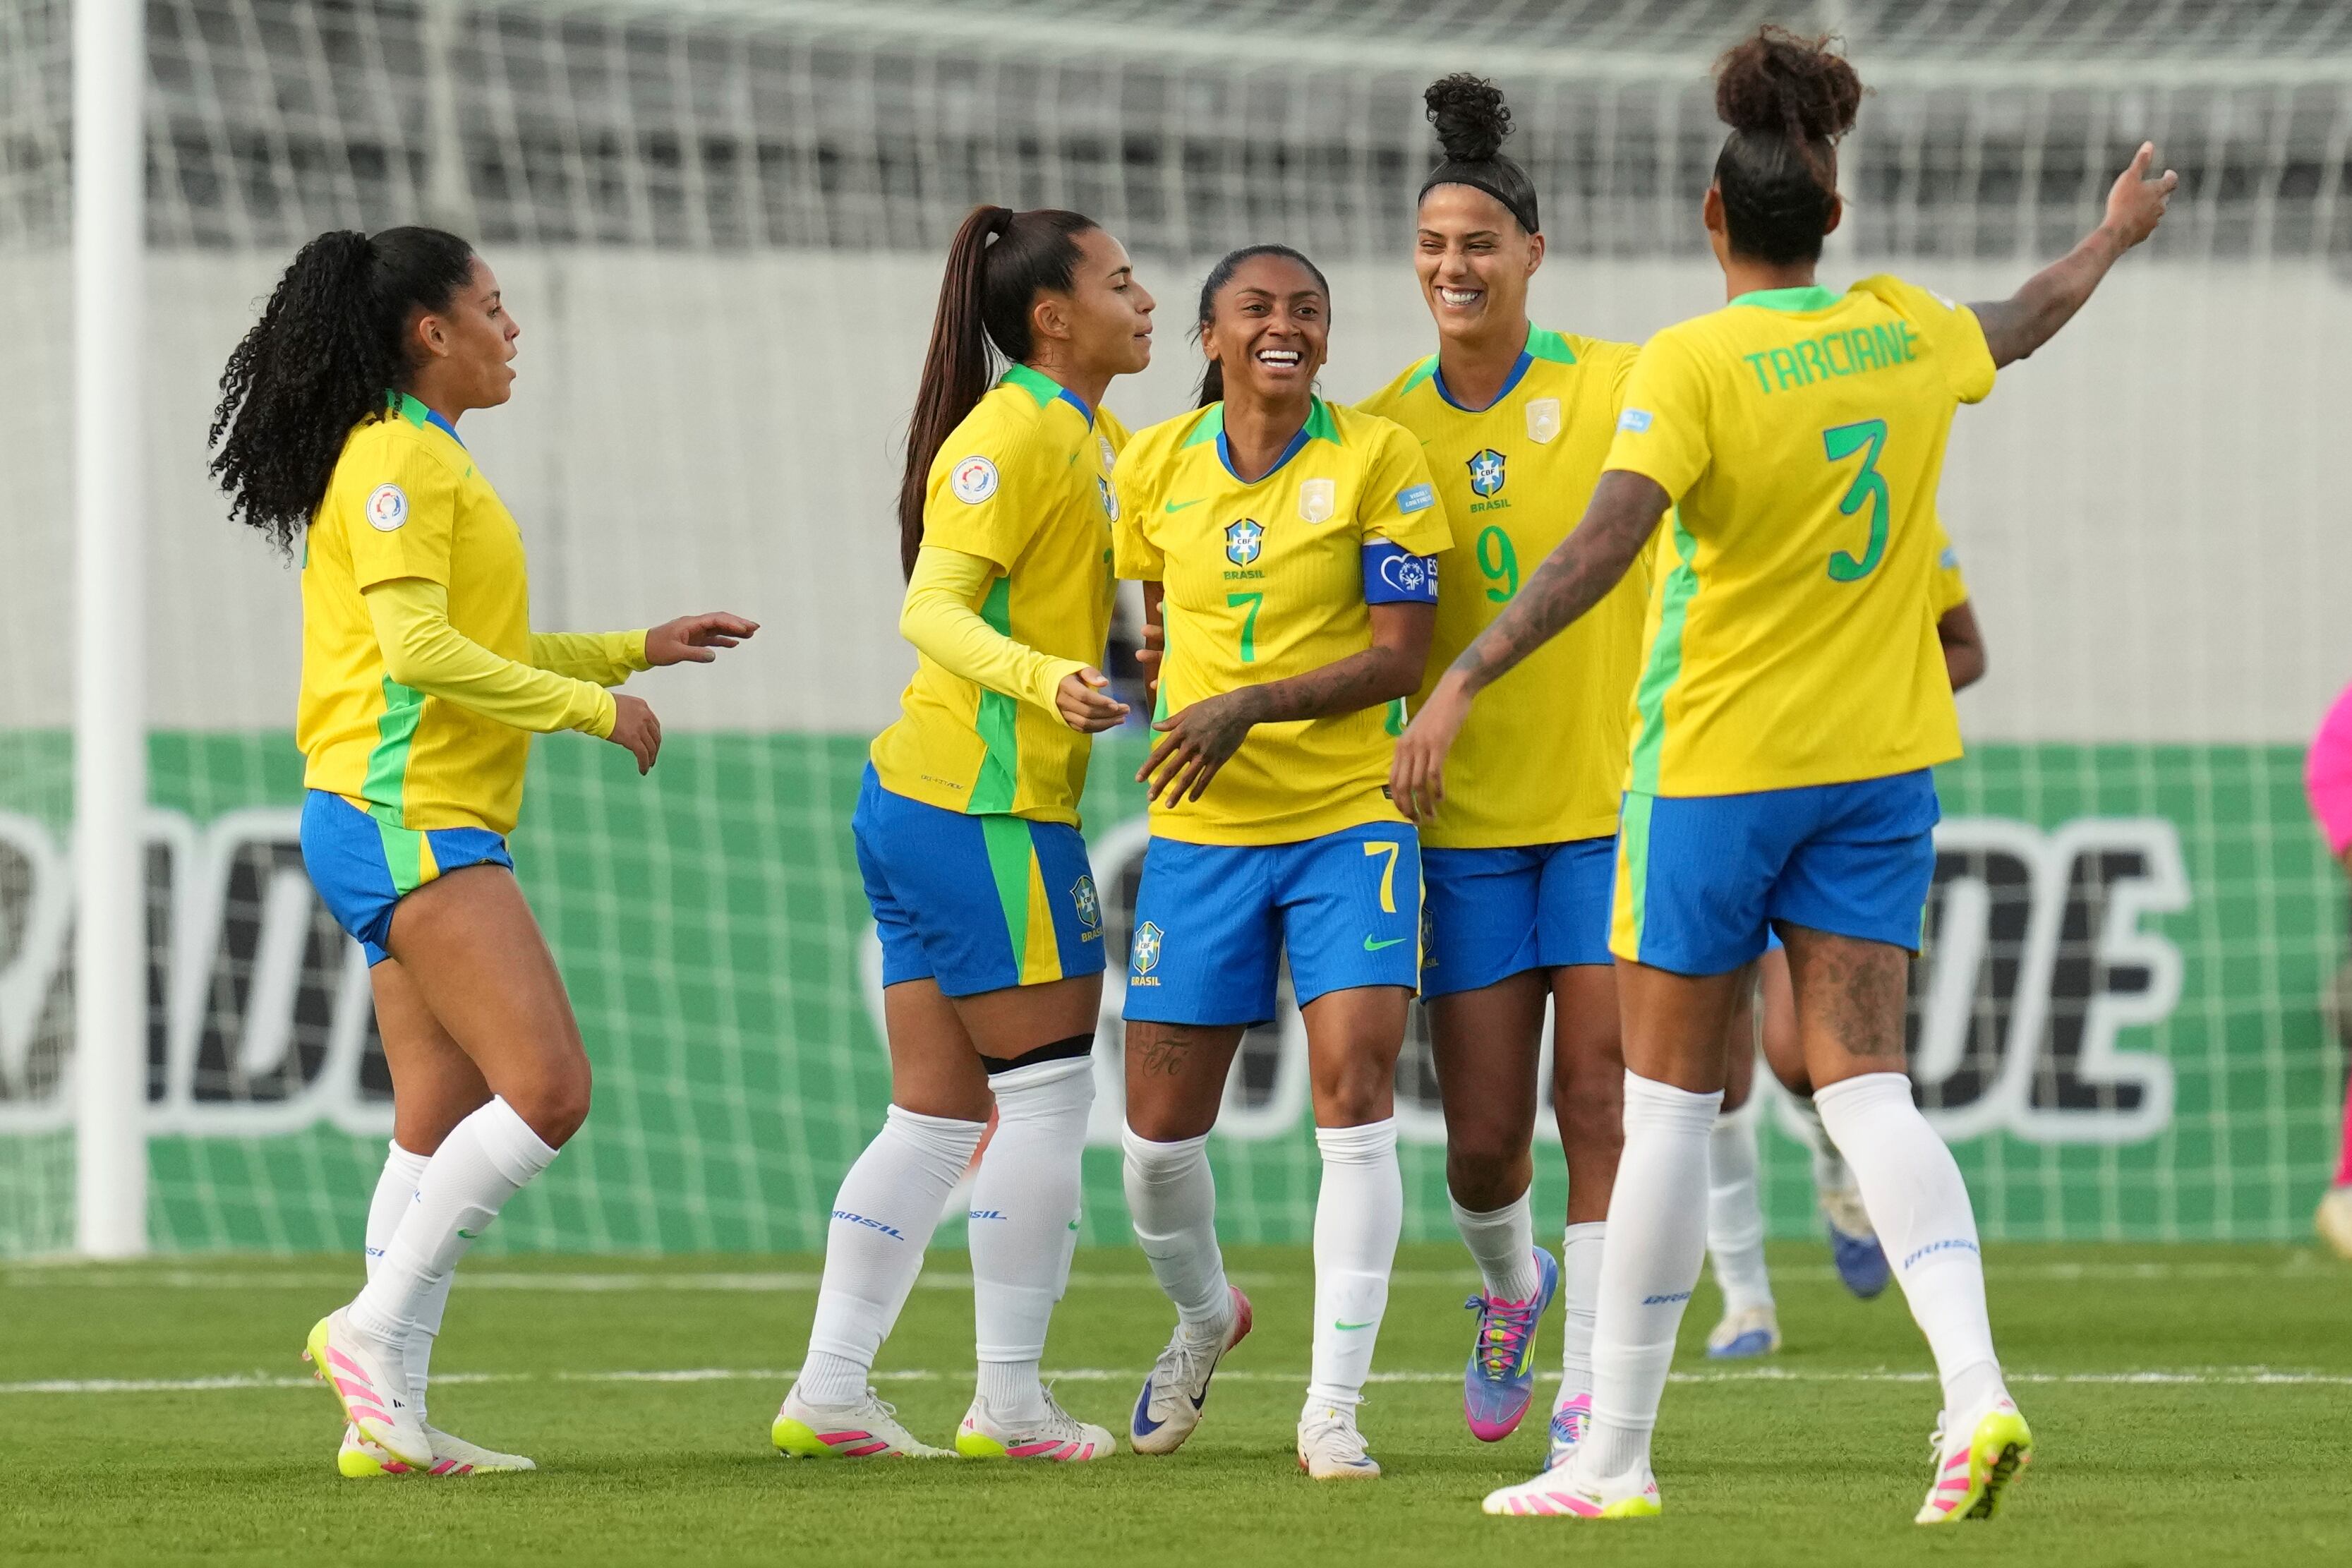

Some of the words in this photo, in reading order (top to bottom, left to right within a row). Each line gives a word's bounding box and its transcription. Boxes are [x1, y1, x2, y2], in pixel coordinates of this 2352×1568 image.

[1743, 322, 1919, 394] TARCIANE
[1470, 499, 1512, 513] BRASIL
[1823, 418, 1890, 583] 3
[1224, 570, 1266, 581] BRASIL
[1476, 525, 1519, 603] 9
[1226, 592, 1263, 662] 7
[1363, 842, 1399, 913] 7
[1130, 976, 1162, 987] BRASIL
